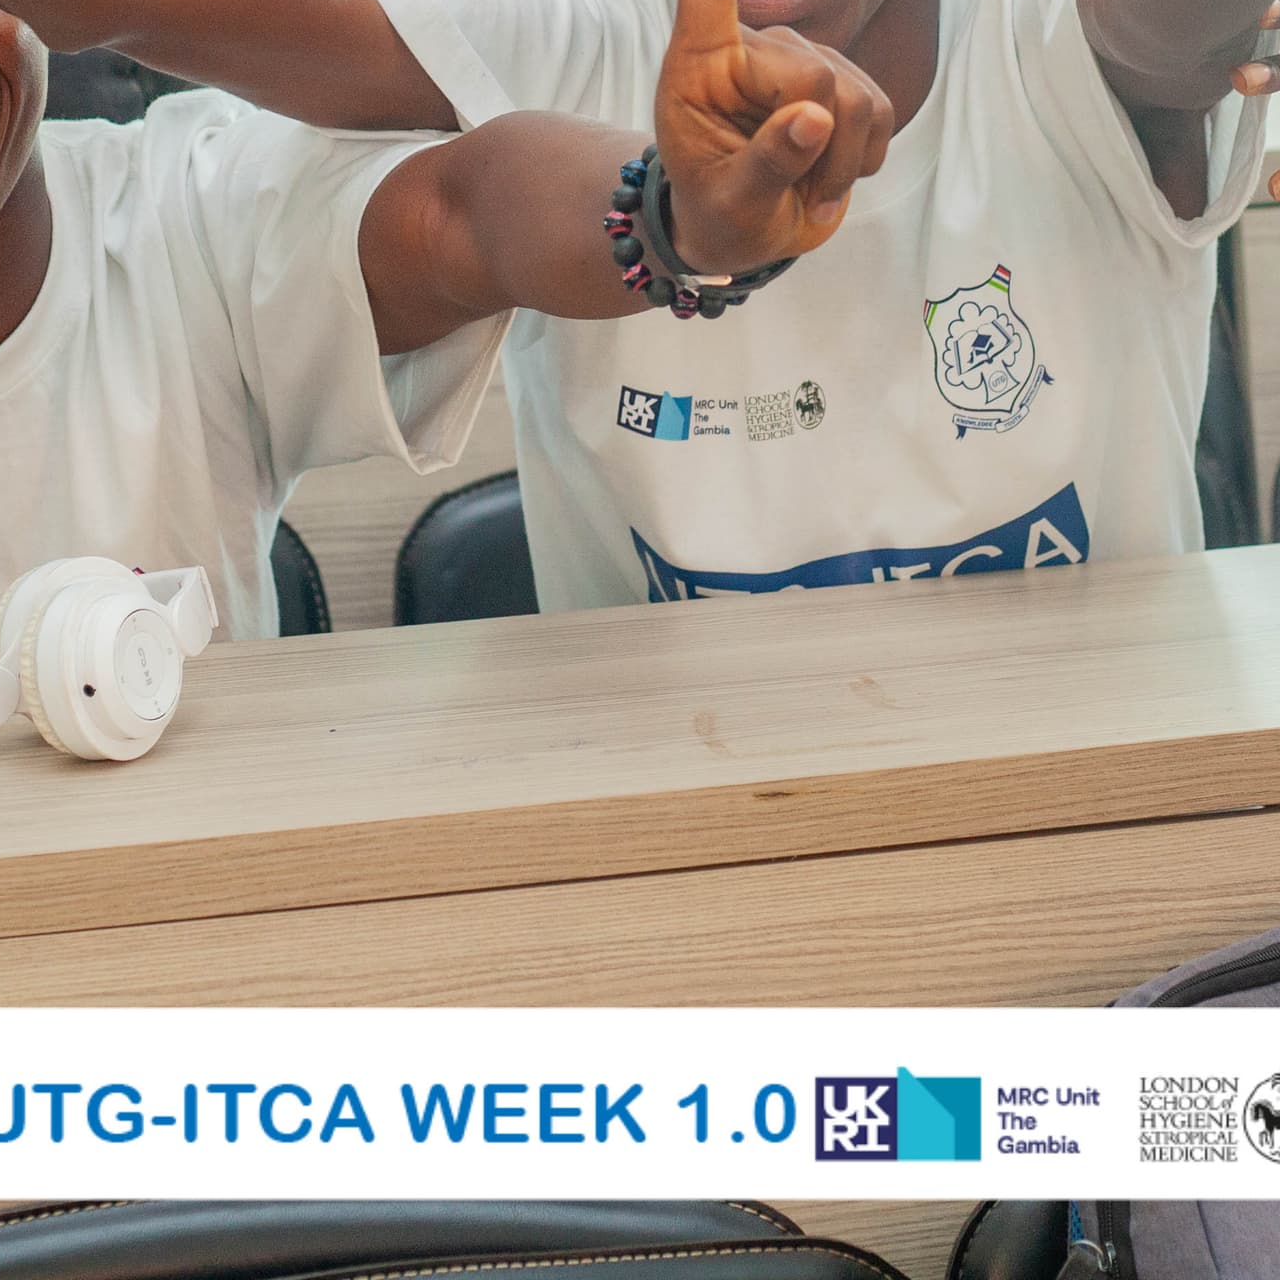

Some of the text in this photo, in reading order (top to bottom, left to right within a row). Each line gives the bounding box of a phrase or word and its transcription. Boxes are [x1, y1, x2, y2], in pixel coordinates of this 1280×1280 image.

[744, 390, 791, 406] LONDON
[694, 400, 738, 410] MRC Unit
[694, 413, 709, 423] The
[746, 409, 793, 424] HYGIENE
[693, 425, 731, 436] Gambia
[748, 427, 795, 441] MEDICINE
